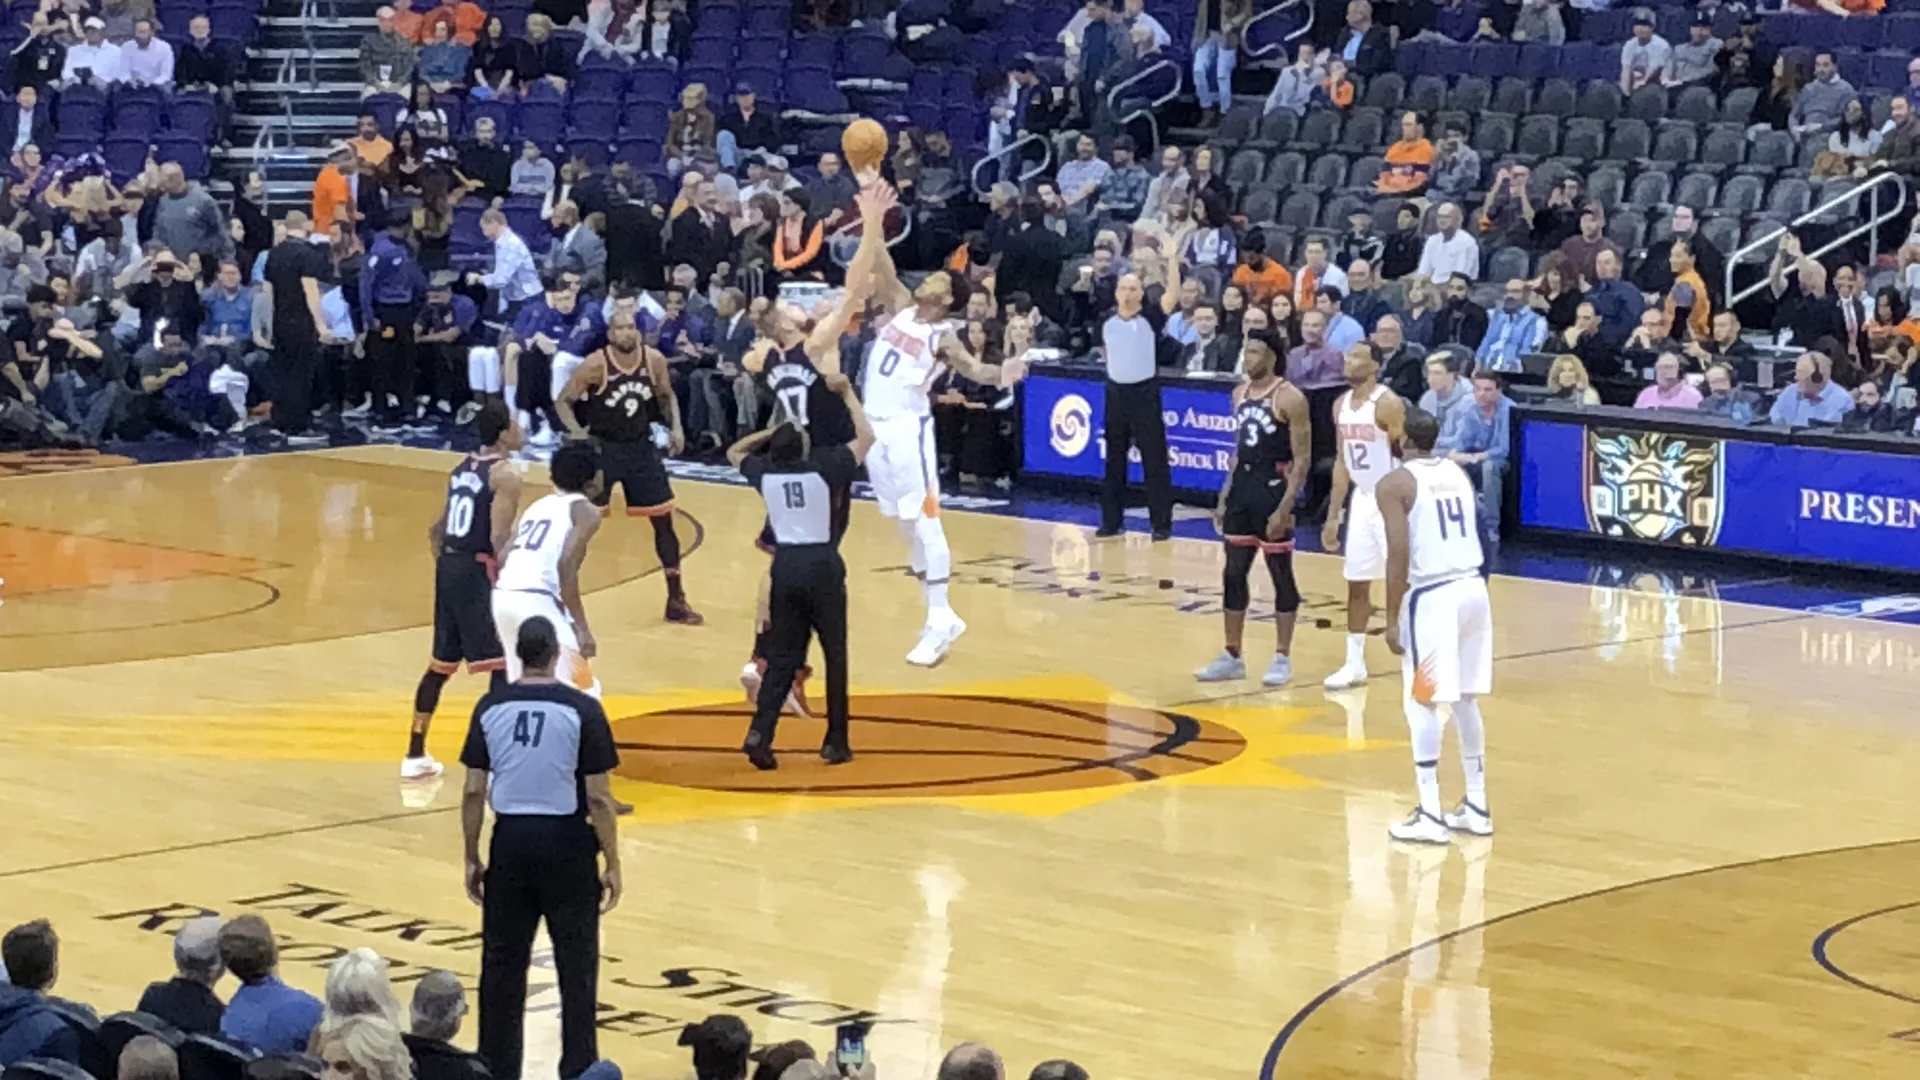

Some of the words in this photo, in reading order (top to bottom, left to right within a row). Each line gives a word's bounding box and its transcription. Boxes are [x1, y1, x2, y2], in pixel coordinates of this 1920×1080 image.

[878, 348, 901, 378] 0
[624, 398, 639, 417] 9
[1182, 406, 1239, 434] ARIZO
[1245, 423, 1259, 448] 3
[1347, 443, 1371, 471] 12
[782, 481, 806, 509] 19
[1621, 482, 1685, 518] PHX
[446, 493, 475, 538] 10
[1435, 496, 1467, 541] 14
[513, 518, 552, 551] 20
[513, 710, 546, 748] 47
